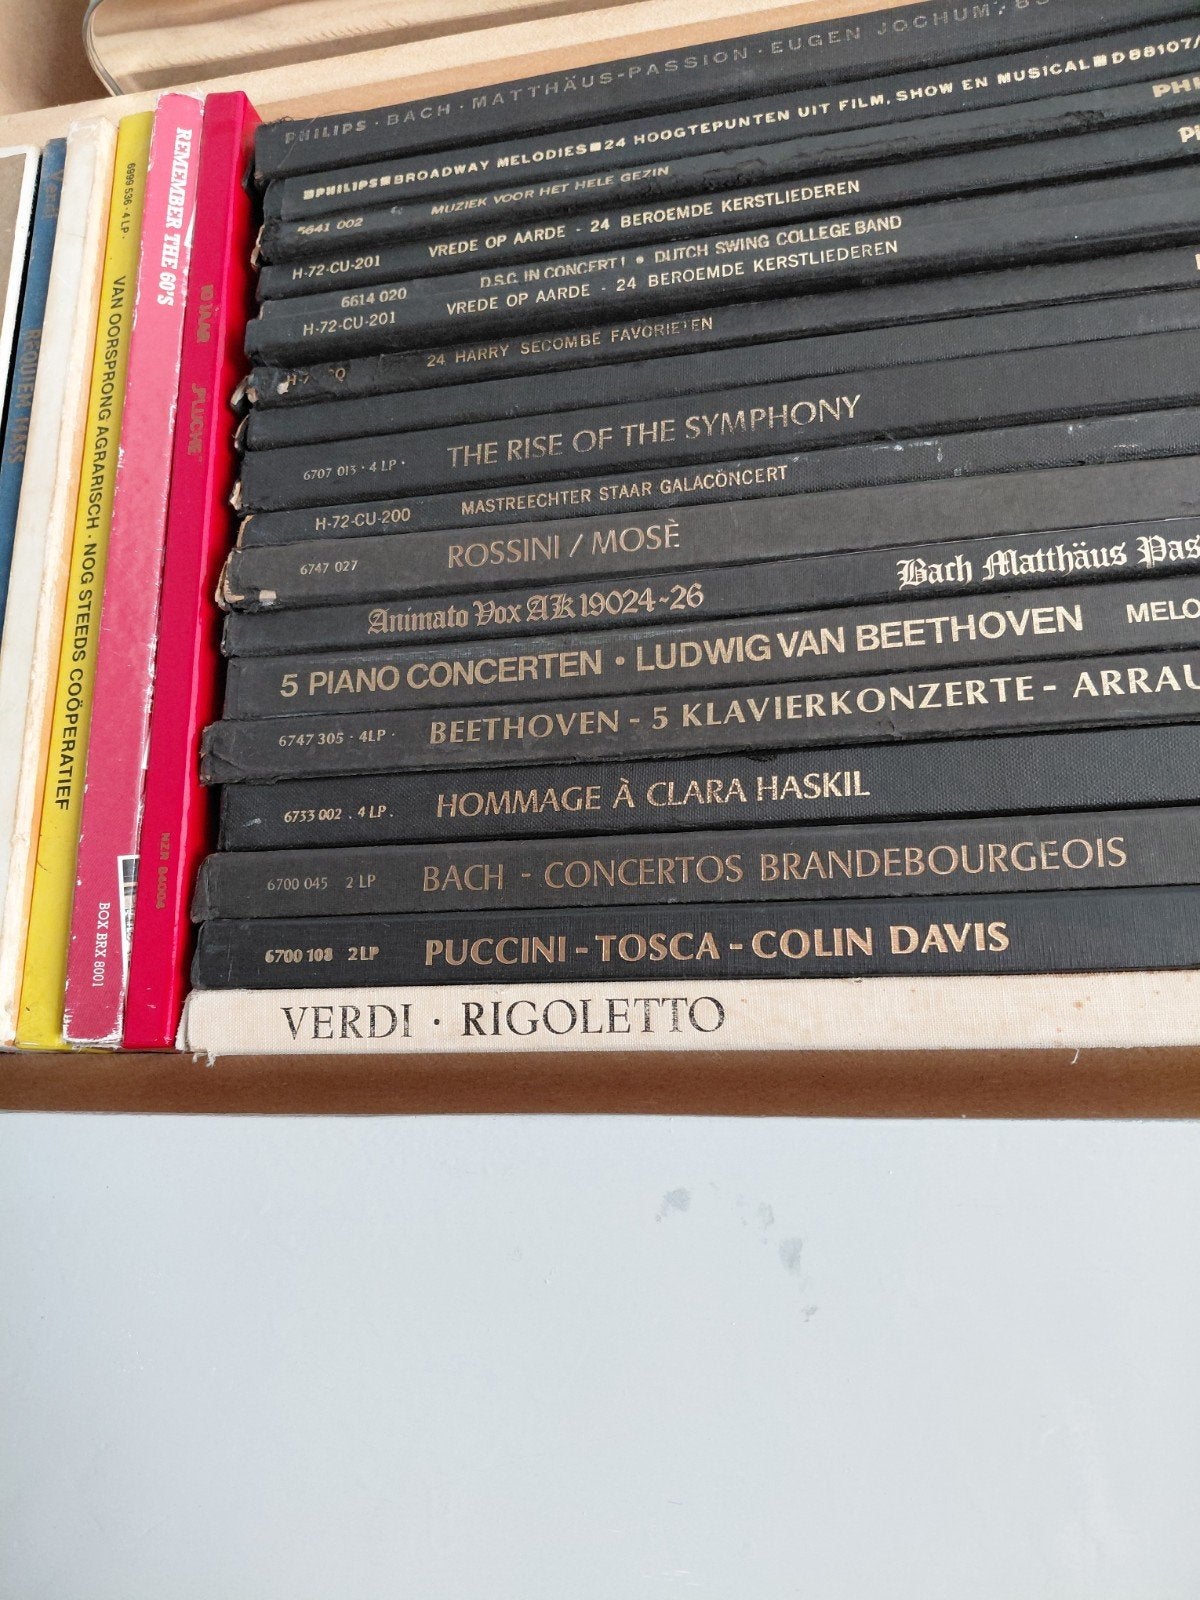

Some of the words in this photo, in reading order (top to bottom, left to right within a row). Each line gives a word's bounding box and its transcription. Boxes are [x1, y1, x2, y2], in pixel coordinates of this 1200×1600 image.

[285, 120, 366, 144] PHILIPS
[387, 103, 450, 126] BACH
[473, 46, 748, 109] MATTHÄUS-PASSION
[771, 27, 861, 54] EUGEN
[394, 160, 489, 185] BROADWAY
[497, 144, 587, 168] MELODIES
[604, 138, 626, 150] 24
[633, 110, 790, 146] HOOGTEPUNTEN
[798, 103, 830, 119] UIT
[896, 82, 953, 101] SHOW
[962, 76, 988, 91] EN
[998, 59, 1090, 84] MUSICAL
[123, 187, 133, 206] 536
[166, 127, 192, 229] REMEMBER
[431, 198, 487, 215] MUZIEK
[493, 189, 534, 204] VOOR
[539, 183, 570, 197] HET
[575, 175, 614, 191] HELE
[620, 166, 669, 183] GEZIN
[337, 217, 363, 229] 002
[428, 239, 478, 258] VREDE
[485, 235, 507, 249] OP
[513, 225, 566, 245] AARDE
[590, 219, 610, 233] 24
[620, 202, 713, 229] BEROEMDE
[721, 180, 860, 214] KERSTLIEDEREN
[161, 233, 181, 270] THE
[292, 255, 380, 280] H-72-CU-201
[524, 268, 540, 282] IN
[655, 244, 708, 263] DUTCH
[715, 234, 770, 254] SWING
[776, 222, 852, 246] COLLEGE
[855, 215, 902, 235] BAND
[111, 275, 126, 308] VAN
[157, 271, 177, 307] 60'S
[341, 292, 375, 308] 6614
[379, 287, 407, 303] 020
[446, 297, 498, 316] VREDE
[506, 293, 529, 307] OP
[535, 284, 590, 303] AARDE
[616, 276, 636, 292] 24
[648, 262, 745, 287] BEROEMDE
[753, 240, 898, 273] KERSTLIEDEREN
[303, 311, 396, 336] H-72-CU-201
[98, 313, 122, 421] OORSPRONG
[426, 354, 445, 367] 24
[455, 345, 509, 363] HARRY
[520, 332, 601, 355] SECOMBE
[447, 441, 498, 468] THE
[507, 434, 563, 462] RISE
[572, 428, 612, 454] OF
[621, 419, 676, 447] THE
[685, 394, 861, 438] SYMPHONY
[86, 425, 109, 529] AGRARISCH
[303, 468, 332, 481] 6707
[337, 465, 357, 477] 013
[369, 461, 377, 472] 4
[315, 508, 411, 531] H-72-CU-200
[461, 489, 591, 515] MASTREECHTER
[599, 481, 652, 501] STAAR
[79, 542, 97, 585] NOG
[448, 534, 559, 568] ROSSINI
[592, 518, 679, 556] MOSÈ
[300, 562, 329, 575] 6747
[335, 560, 358, 573] 027
[896, 555, 972, 591] Bach
[982, 541, 1126, 582] Matthäus
[71, 589, 93, 661] STEEDS
[368, 606, 469, 635] Animato
[472, 599, 521, 627] Vox
[580, 582, 705, 618] 19024-26
[279, 672, 298, 697] 5
[308, 665, 400, 696] PIANO
[406, 649, 602, 688] CONCERTEN
[637, 633, 772, 671] LUDWIG
[776, 627, 845, 657] VAN
[856, 604, 1083, 652] BEETHOVEN
[429, 709, 620, 745] BEETHOVEN
[652, 706, 668, 731] 5
[682, 674, 1034, 728] KLAVIERKONZERTE
[55, 668, 84, 811] COÖPERATIEF
[279, 733, 314, 747] 6747
[317, 732, 344, 745] 305
[284, 809, 315, 823] 6733
[318, 808, 342, 821] 002
[436, 785, 601, 818] HOMMAGE
[611, 777, 634, 808] À
[645, 776, 747, 806] CLARA
[756, 770, 870, 801] HASKIL
[267, 878, 299, 890] 6700
[304, 876, 328, 890] 045
[346, 877, 354, 889] 2
[359, 874, 376, 889] LP
[423, 864, 504, 892] BACH
[545, 854, 743, 889] CONCERTOS
[760, 837, 1127, 881] BRANDEBOURGEOIS
[97, 902, 111, 929] BOX
[95, 932, 108, 958] BRX
[264, 948, 303, 964] 6700
[306, 947, 333, 962] 108
[425, 936, 567, 966] PUCCINI
[595, 931, 720, 961] TOSCA
[751, 926, 873, 959] COLIN
[891, 921, 1010, 955] DAVIS
[92, 961, 105, 987] 8001
[281, 1003, 413, 1040] VERDI
[461, 996, 725, 1037] RIGOLETTO
